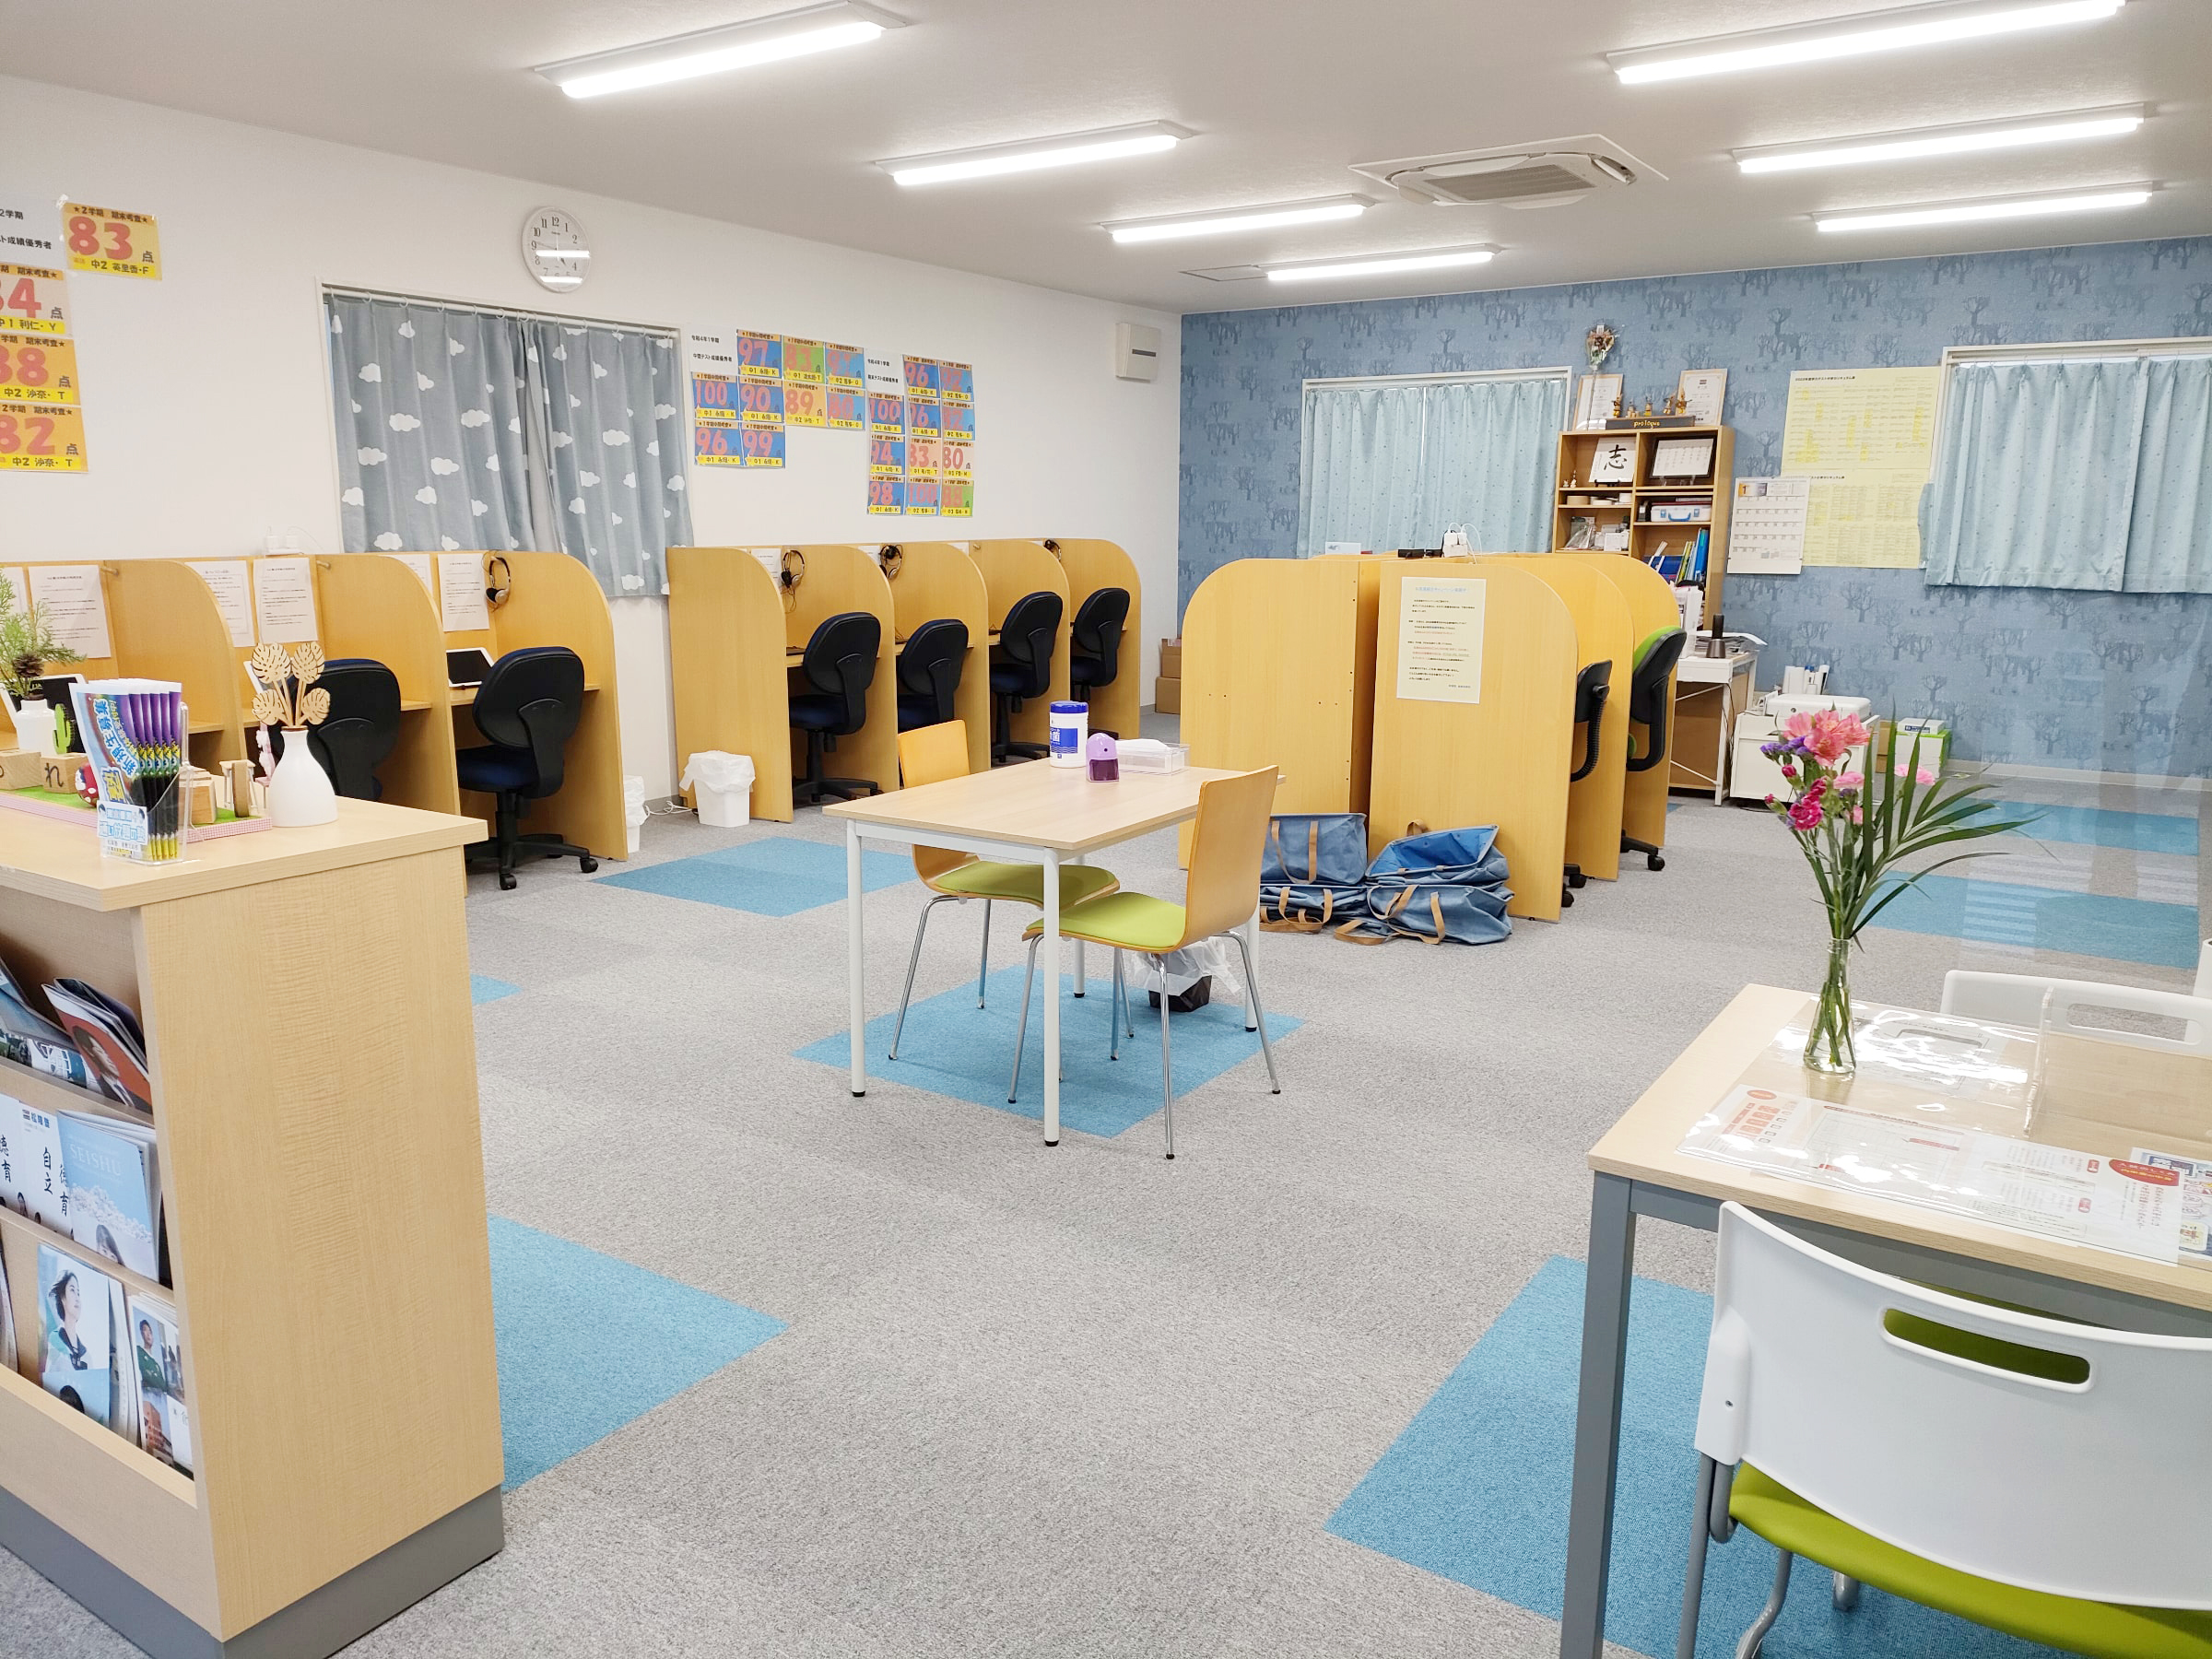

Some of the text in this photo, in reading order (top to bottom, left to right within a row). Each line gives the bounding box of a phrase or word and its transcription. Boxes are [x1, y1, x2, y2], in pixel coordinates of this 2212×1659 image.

[551, 217, 559, 227] 12
[68, 216, 154, 264] 83 点
[91, 259, 108, 270] 中2
[0, 277, 64, 320] 4 点
[738, 337, 768, 367] 97
[59, 375, 71, 388] 点
[904, 362, 929, 387] 96
[5, 388, 22, 397] 中2
[696, 381, 727, 406] 100
[741, 384, 771, 411] 90
[785, 389, 814, 416] 89
[869, 399, 900, 421] 100
[0, 415, 78, 455] 82 点
[696, 428, 728, 455] 96
[743, 430, 772, 457] 99
[12, 457, 29, 466] 中2
[943, 447, 964, 469] 80
[1604, 444, 1628, 470] 志
[869, 482, 893, 506] 98
[909, 484, 937, 504] 100
[95, 699, 136, 776] 新規生募集
[43, 1147, 53, 1194] 自立
[69, 1143, 122, 1176] SEISHU
